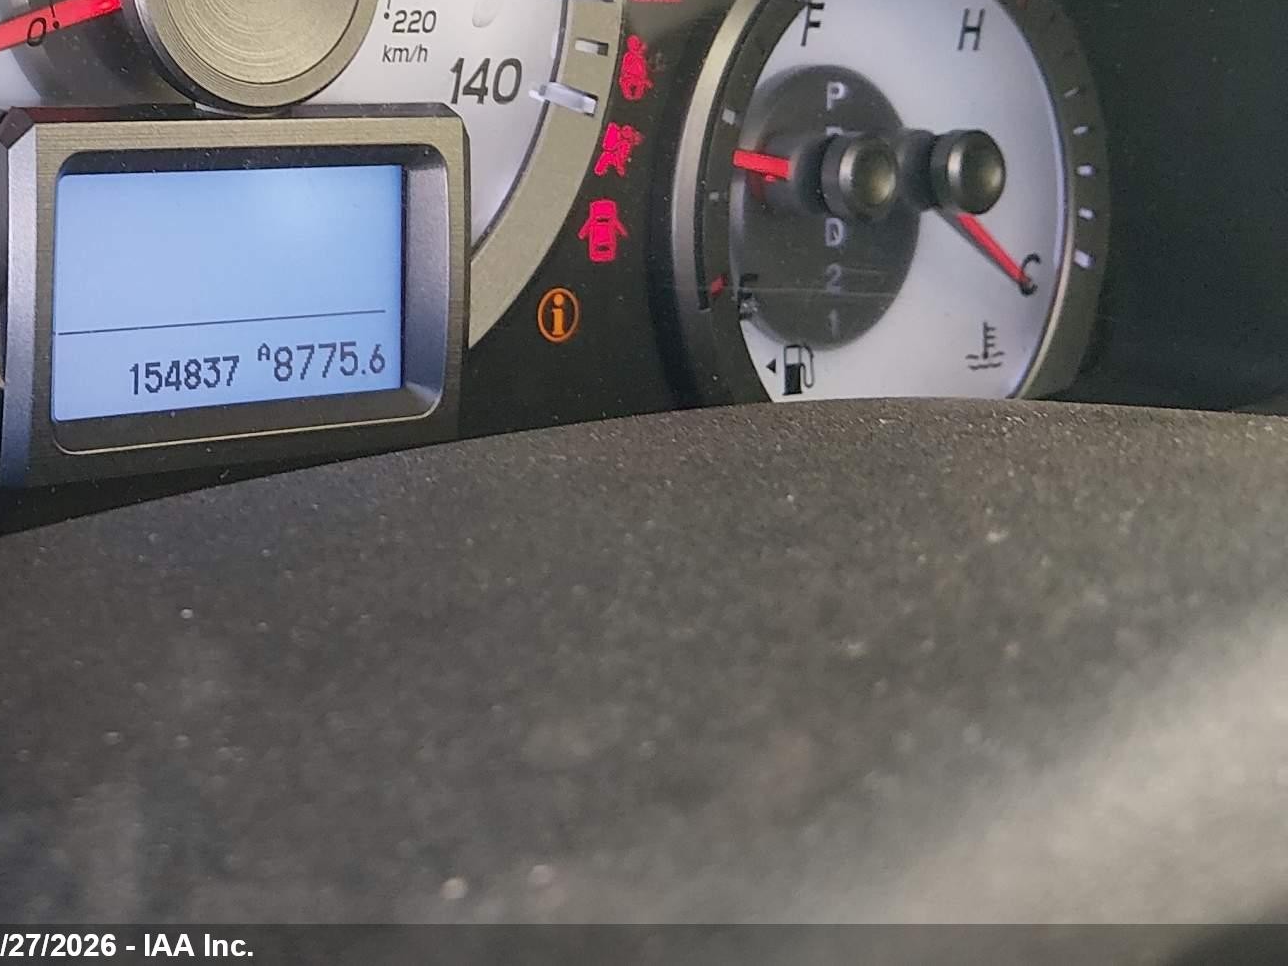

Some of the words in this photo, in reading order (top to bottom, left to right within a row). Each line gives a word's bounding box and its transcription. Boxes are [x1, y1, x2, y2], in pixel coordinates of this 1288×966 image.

[26, 18, 48, 47] 0
[392, 11, 437, 34] 220
[801, 2, 825, 47] F
[958, 8, 985, 51] H
[381, 43, 428, 64] km/h
[449, 58, 523, 104] 140
[825, 82, 844, 111] P
[824, 217, 844, 247] D
[826, 263, 842, 295] 2
[1020, 253, 1041, 296] C
[129, 355, 239, 395] 154837
